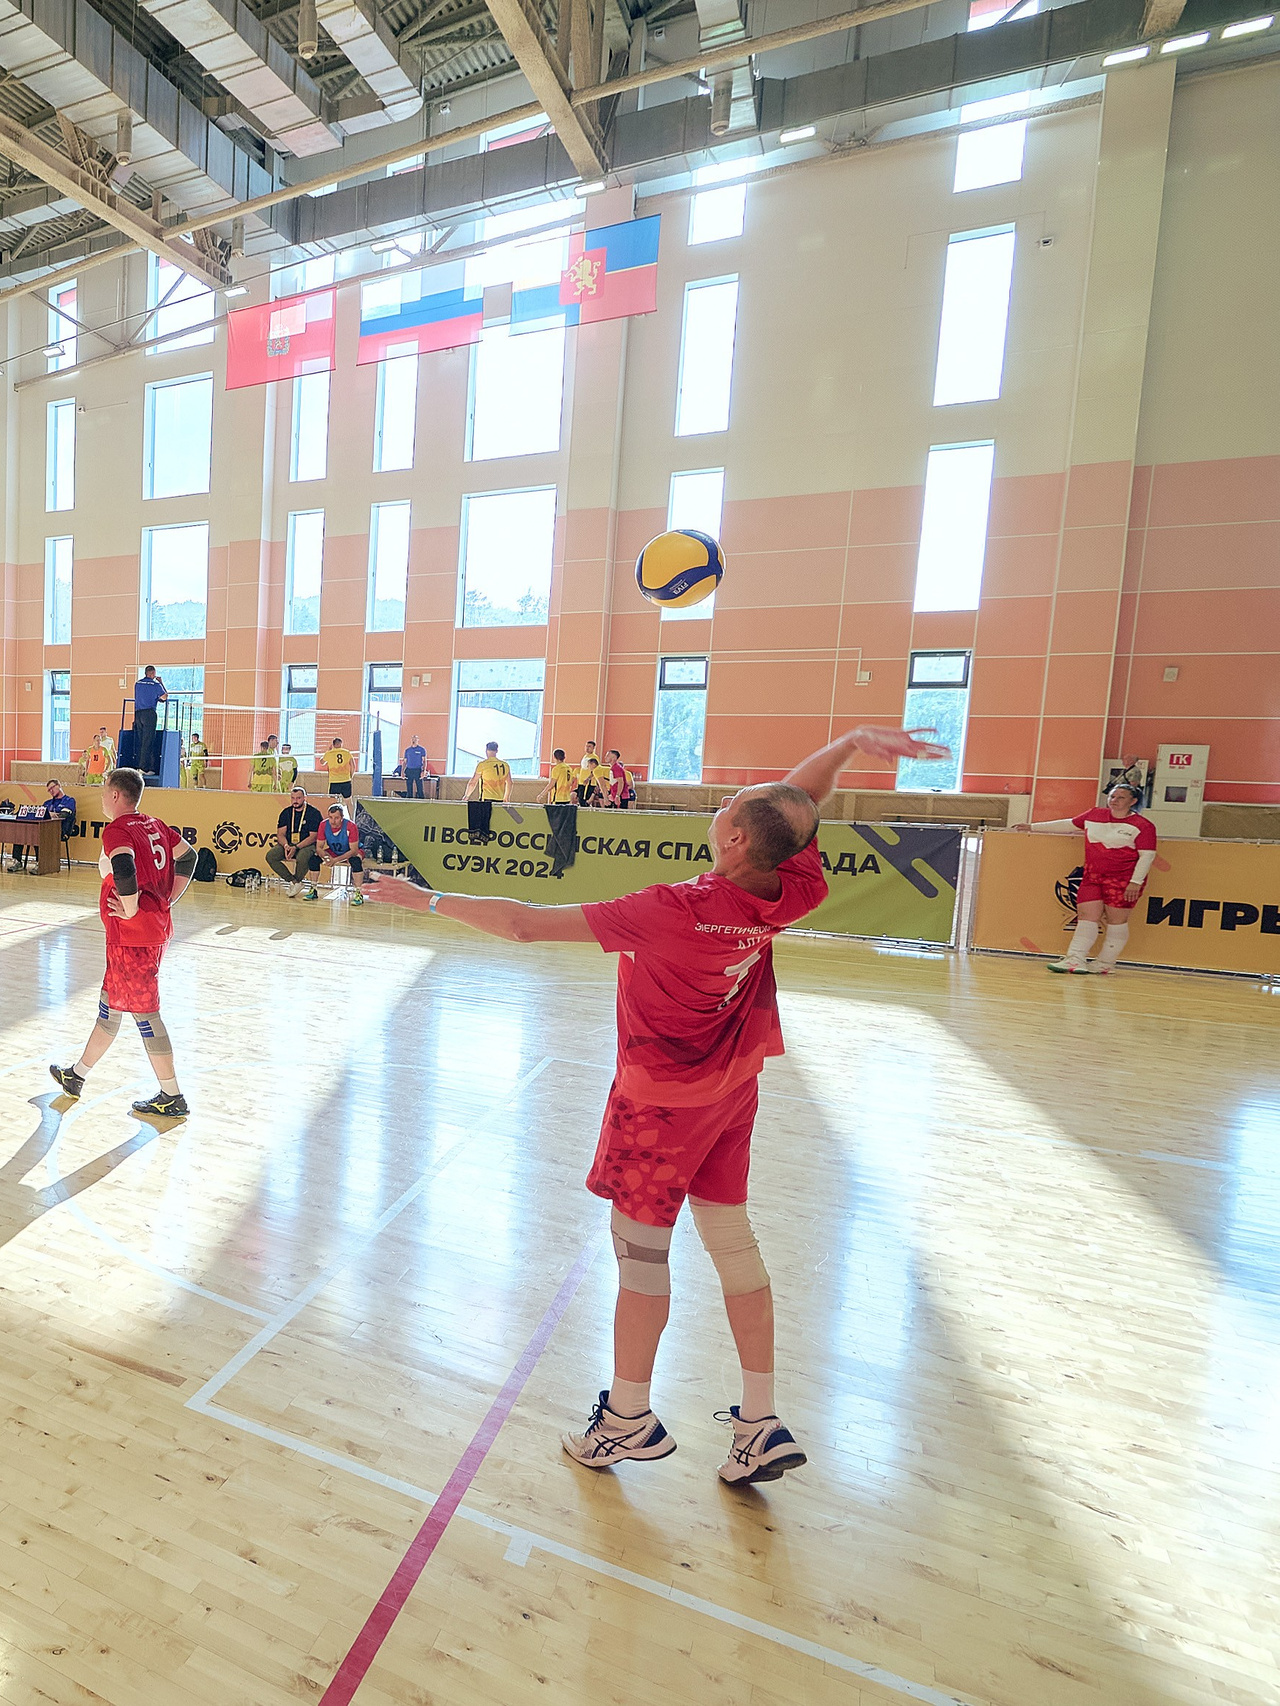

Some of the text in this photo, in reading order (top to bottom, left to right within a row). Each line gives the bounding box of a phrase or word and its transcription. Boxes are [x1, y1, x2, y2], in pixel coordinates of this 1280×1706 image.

[260, 757, 267, 768] 2
[336, 753, 343, 764] 8
[1172, 754, 1190, 765] ПК
[493, 763, 506, 776] 11
[245, 831, 278, 849] СУЭ
[147, 832, 167, 871] 5
[441, 827, 651, 859] ВСРОСССКАЯ
[656, 840, 882, 877] СПААДА
[443, 853, 500, 875] СУЭК
